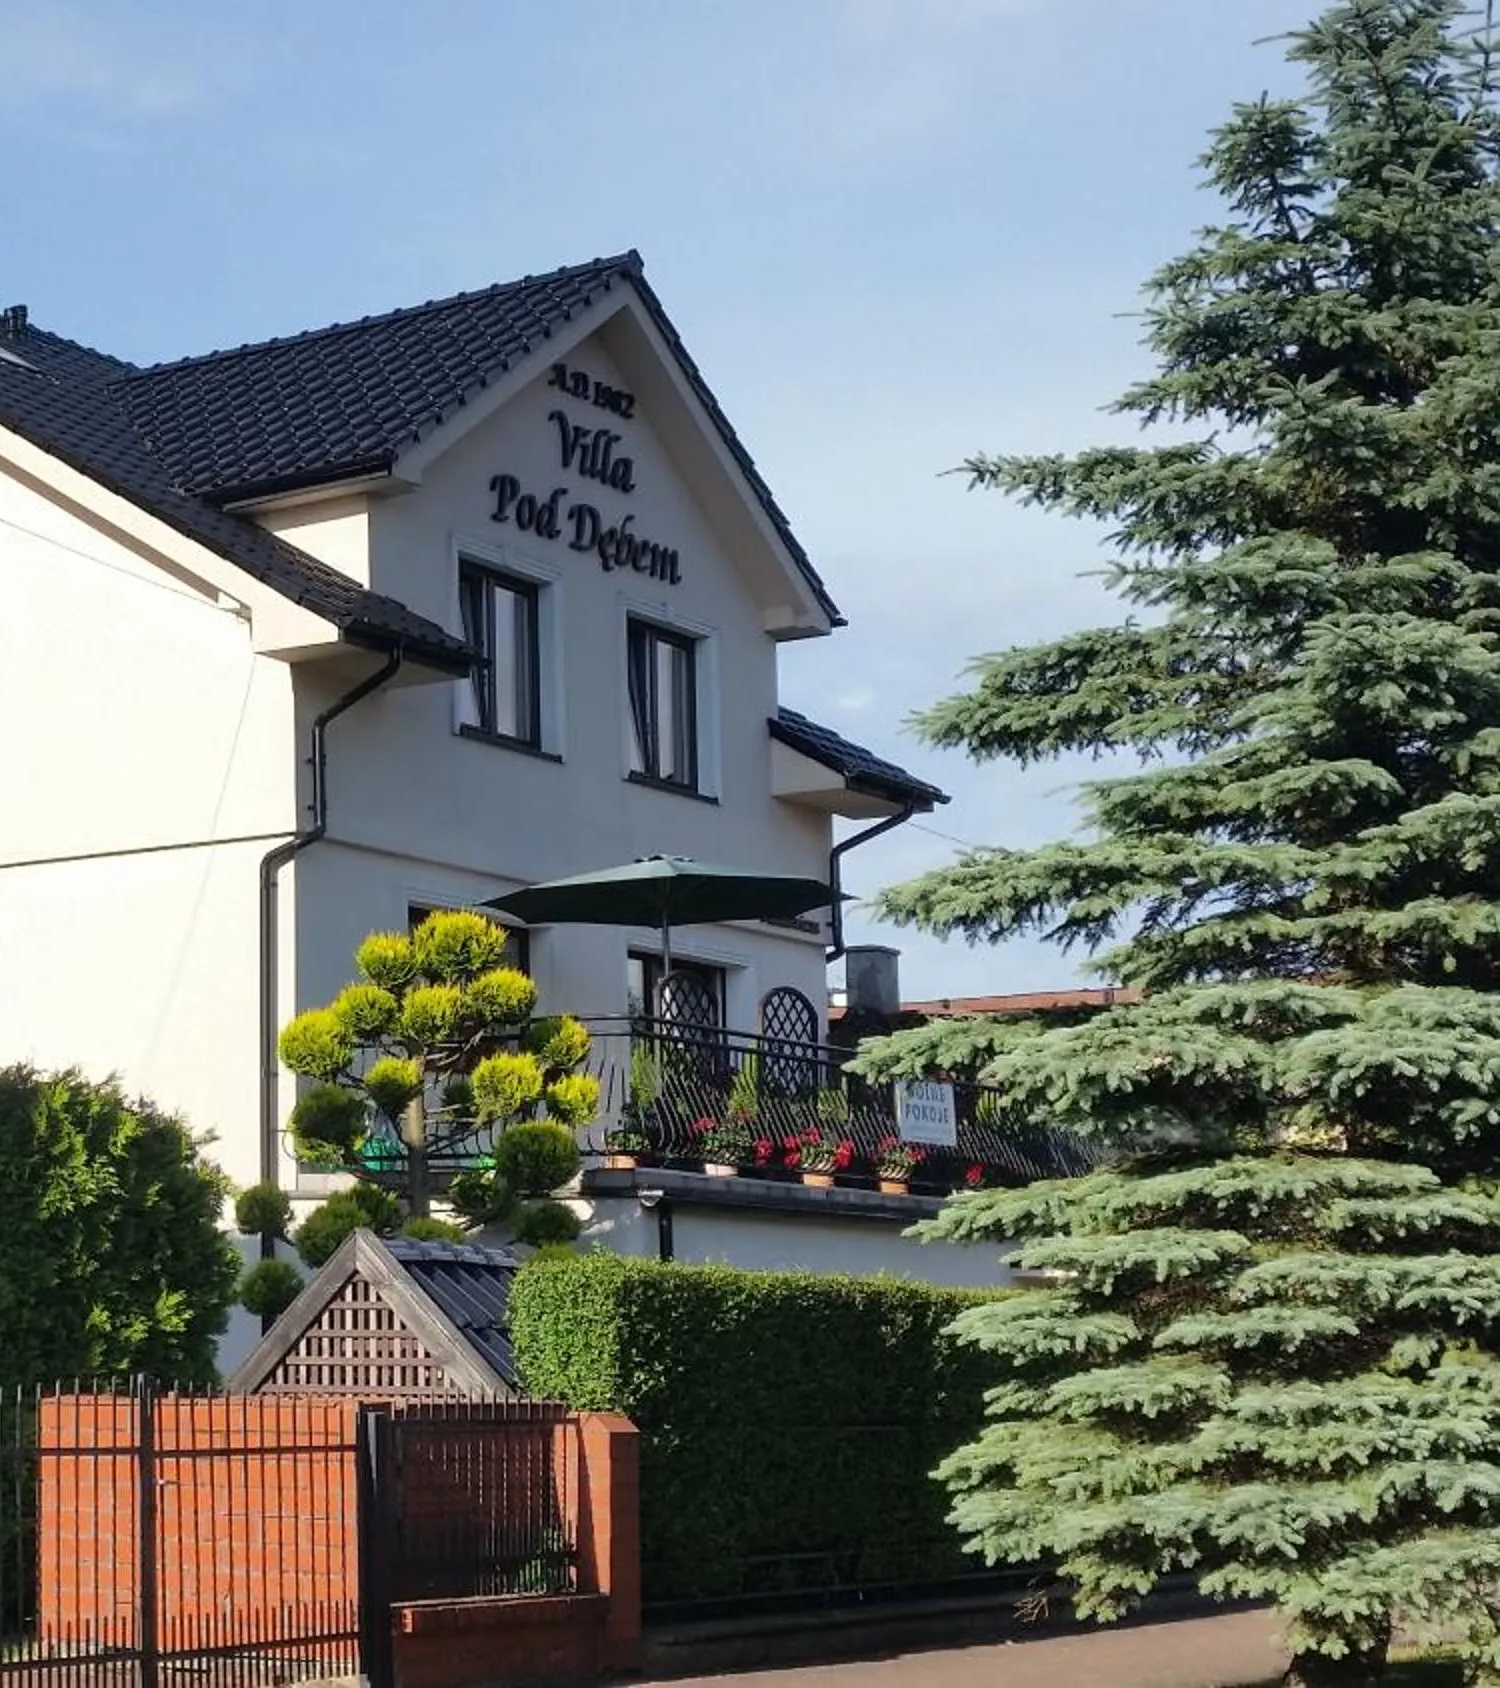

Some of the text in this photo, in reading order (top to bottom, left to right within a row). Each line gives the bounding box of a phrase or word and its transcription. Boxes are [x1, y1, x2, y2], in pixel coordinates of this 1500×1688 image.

[548, 409, 636, 493] Villa
[489, 473, 682, 585] Pod Dębem
[905, 1103, 949, 1124] POKOJE
